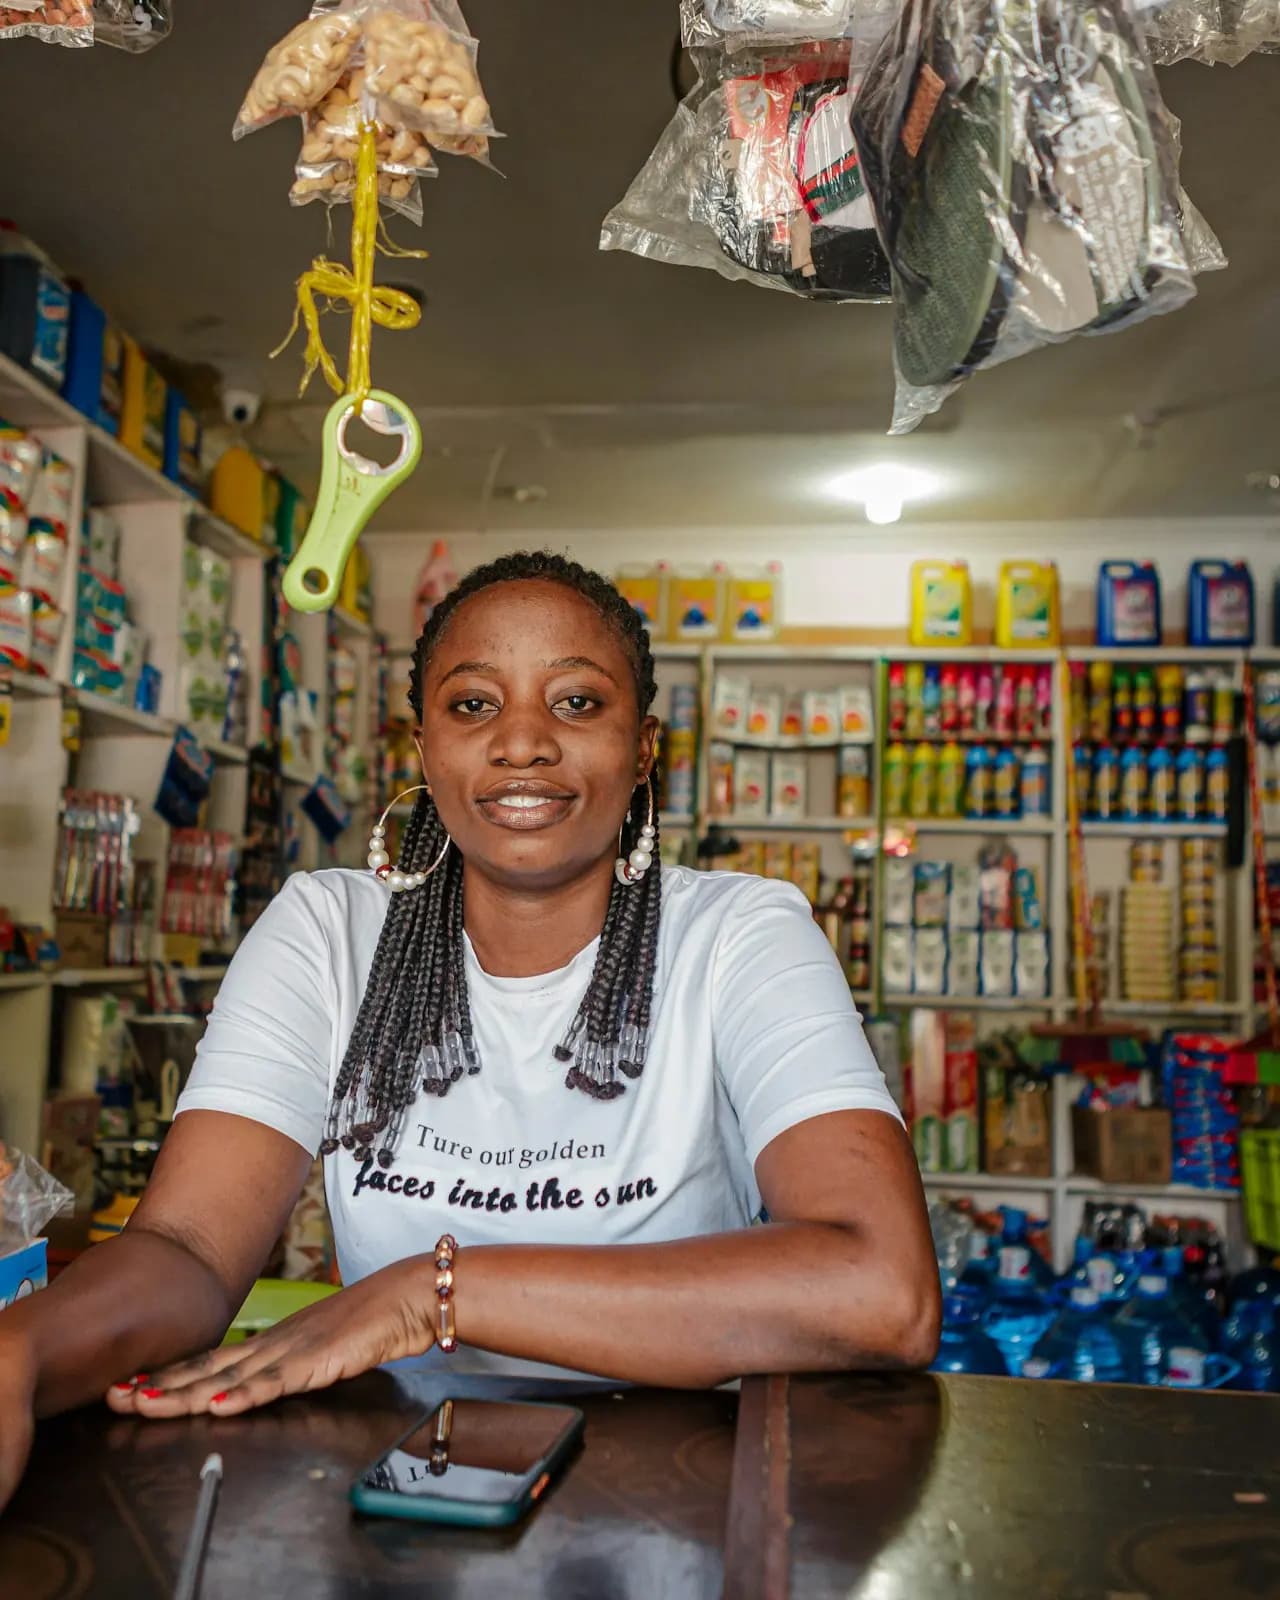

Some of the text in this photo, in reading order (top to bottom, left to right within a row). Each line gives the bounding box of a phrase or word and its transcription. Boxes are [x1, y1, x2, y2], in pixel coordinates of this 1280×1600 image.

[417, 1123, 606, 1169] Ture our golden
[352, 1157, 435, 1199] faces
[448, 1178, 517, 1213] into
[525, 1177, 584, 1211] the
